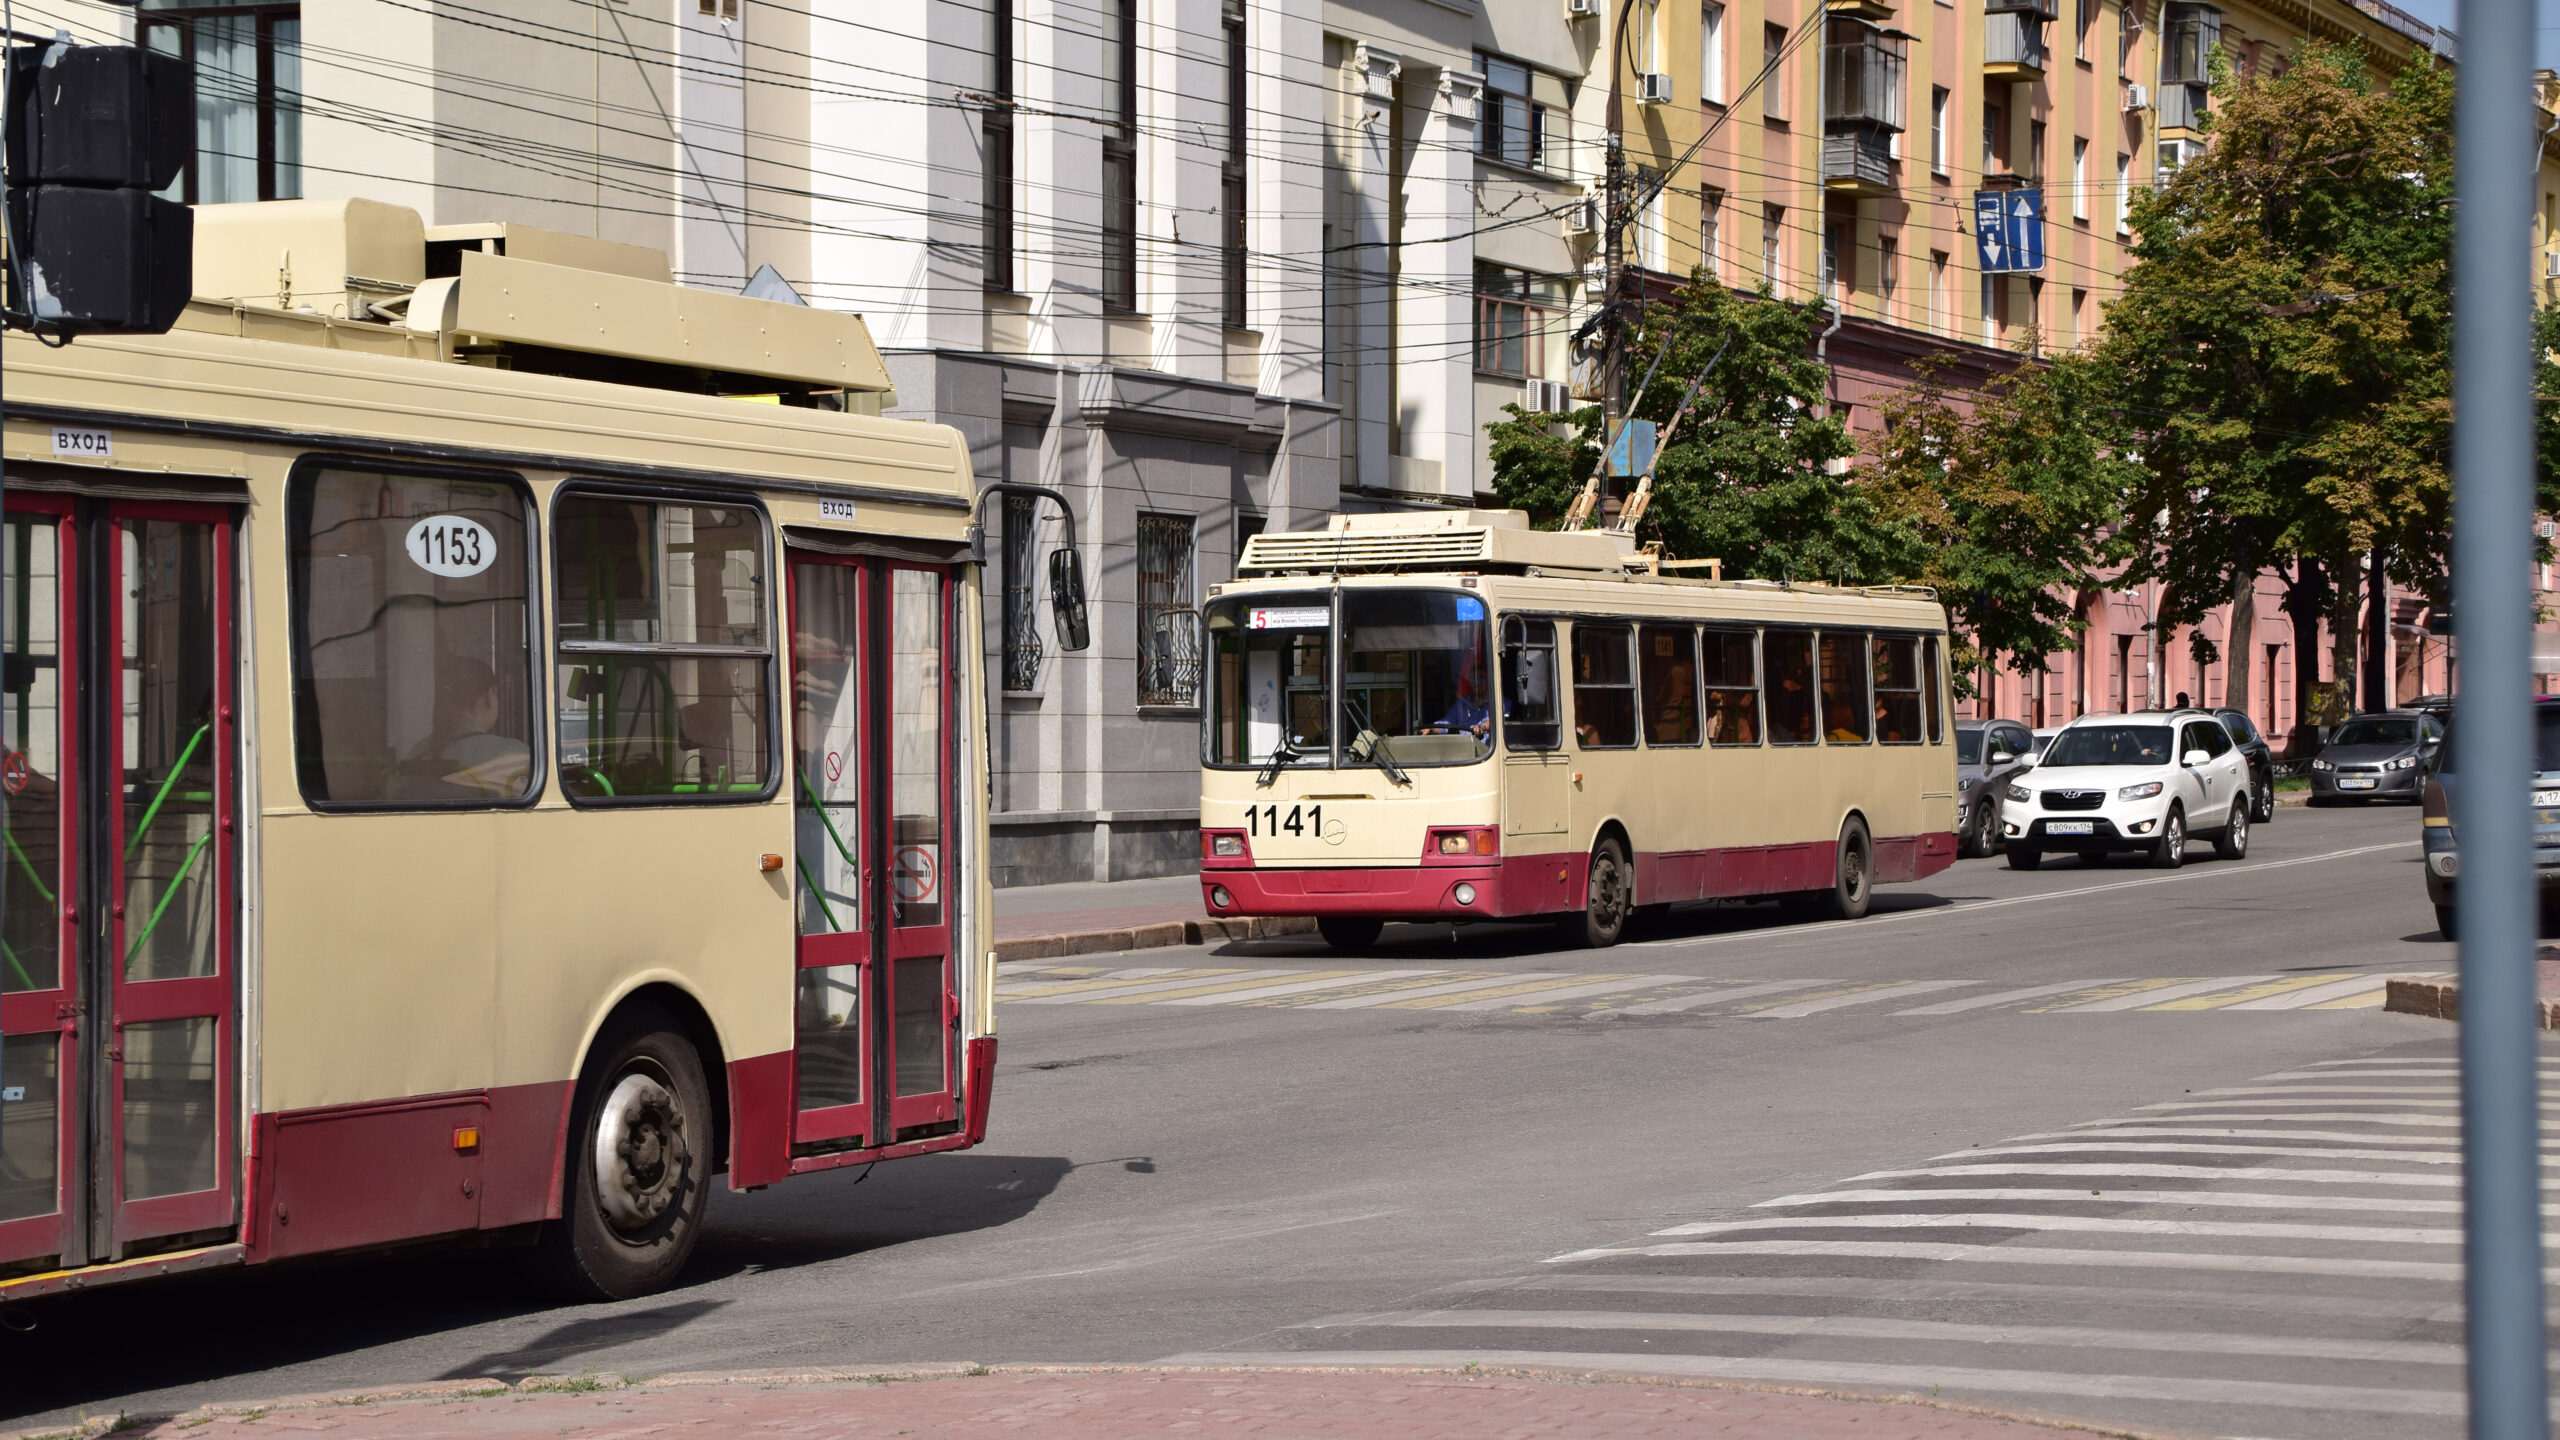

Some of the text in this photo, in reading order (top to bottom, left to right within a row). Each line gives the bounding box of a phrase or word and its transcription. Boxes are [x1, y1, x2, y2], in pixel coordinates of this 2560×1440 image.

[58, 433, 108, 454] ВХОД
[822, 502, 853, 519] ВХОД
[419, 525, 481, 566] 1153
[1256, 611, 1267, 629] 5
[1244, 804, 1321, 837] 1141
